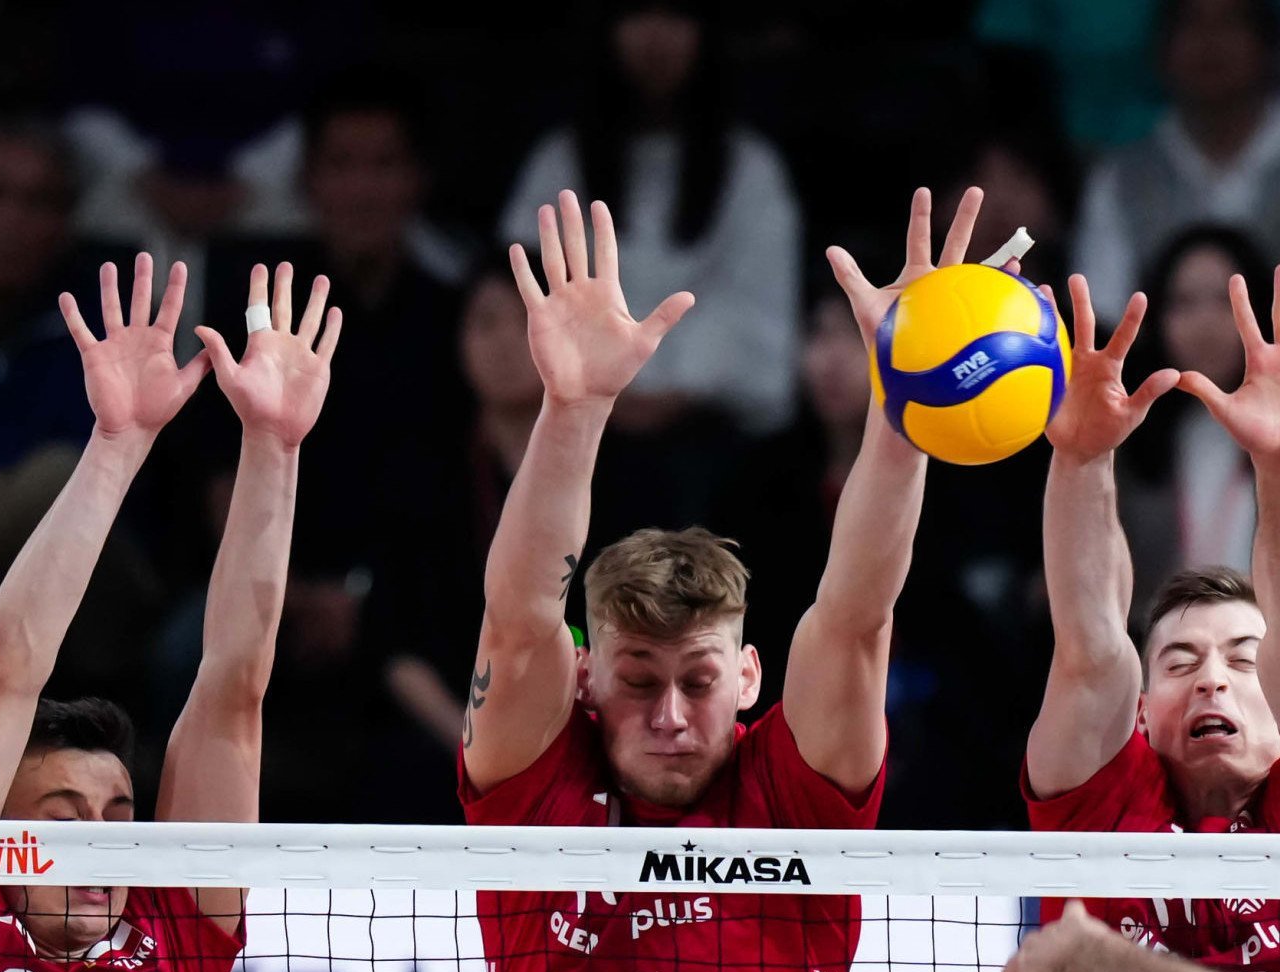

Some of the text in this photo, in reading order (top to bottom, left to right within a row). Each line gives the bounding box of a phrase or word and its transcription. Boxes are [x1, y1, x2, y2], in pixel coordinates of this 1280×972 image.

[952, 351, 991, 380] FIVB
[639, 850, 811, 885] MIKASA
[631, 896, 713, 939] plus
